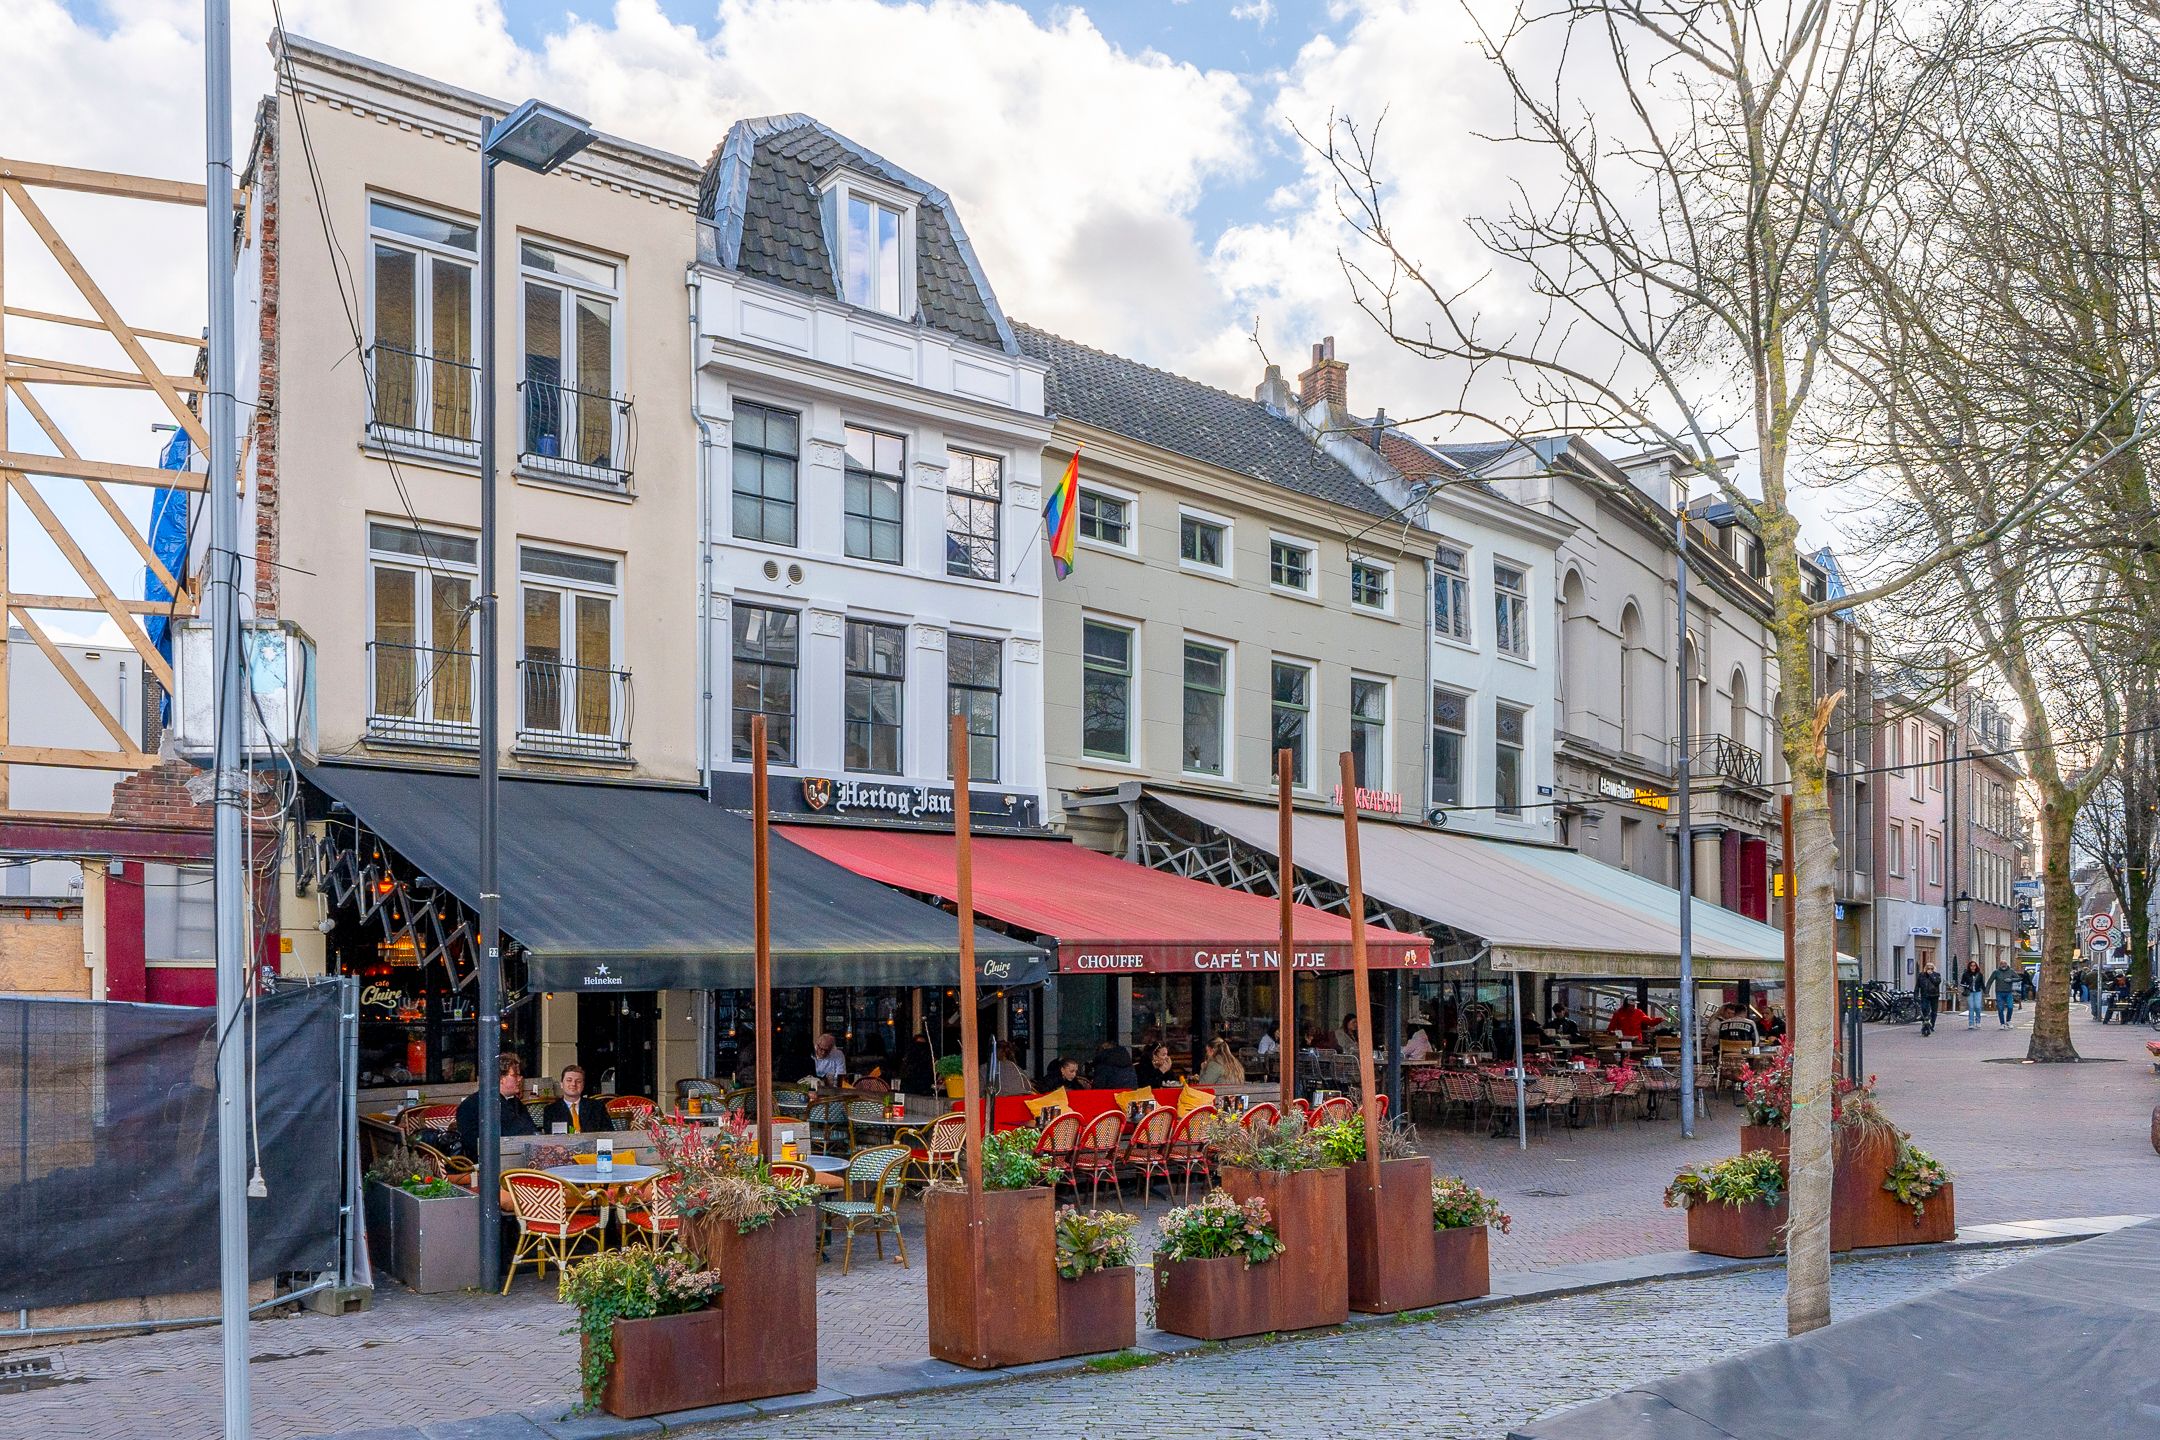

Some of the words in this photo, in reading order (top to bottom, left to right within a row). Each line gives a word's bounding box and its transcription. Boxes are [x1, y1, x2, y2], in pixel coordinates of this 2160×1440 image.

[836, 780, 911, 815] Hertog
[912, 785, 953, 818] Jan
[1600, 777, 1635, 802] Hawaiian
[984, 959, 1011, 978] Claire
[1077, 954, 1144, 969] CHOUFFE
[1194, 949, 1242, 969] CAFÉ
[1264, 950, 1326, 968] NTJE
[374, 979, 390, 987] café
[583, 976, 623, 985] Heineken
[361, 985, 403, 1007] Claire
